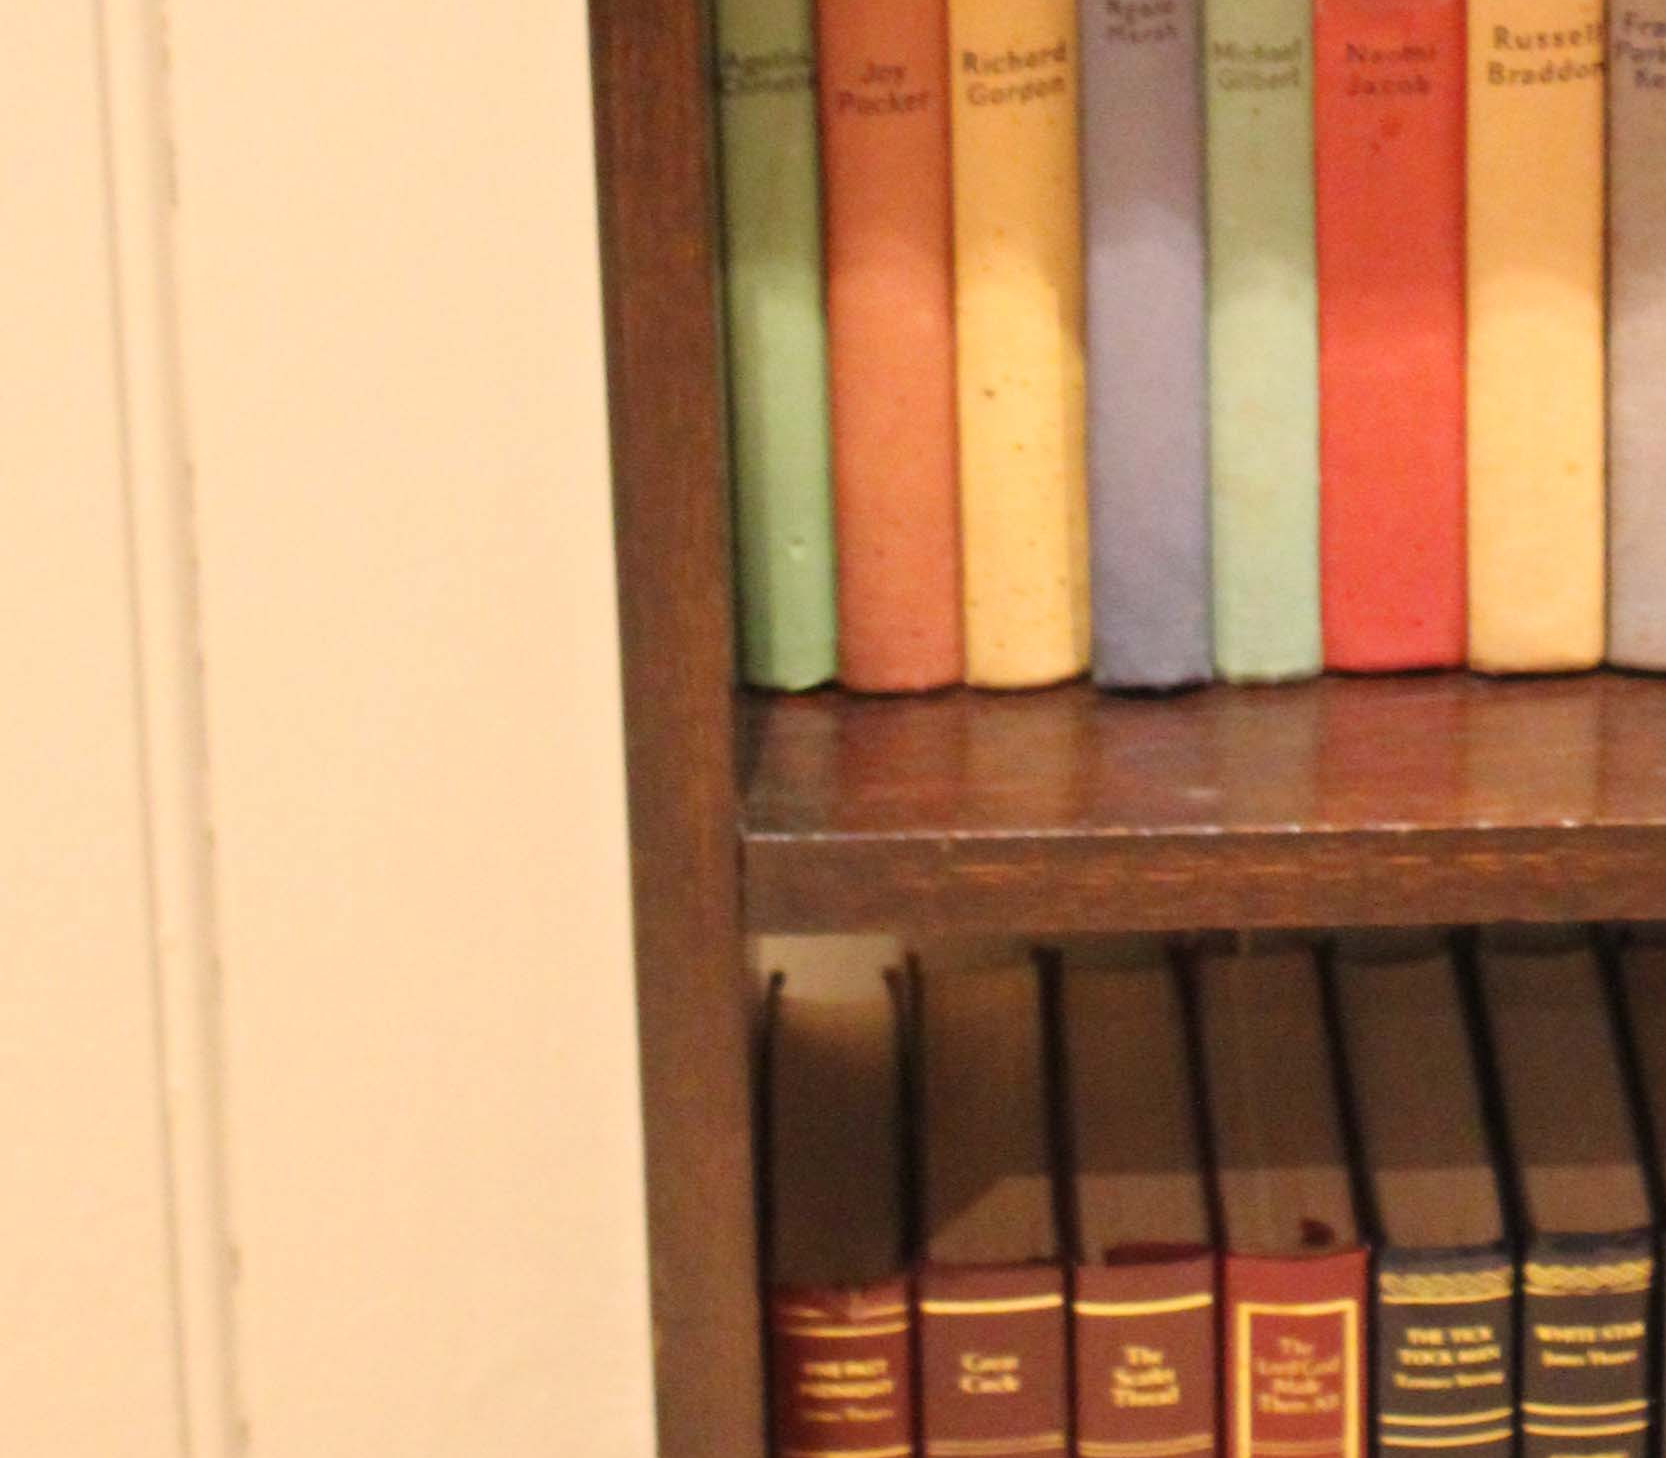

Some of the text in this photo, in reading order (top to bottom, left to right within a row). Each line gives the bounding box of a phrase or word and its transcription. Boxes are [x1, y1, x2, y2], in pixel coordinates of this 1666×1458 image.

[1492, 23, 1603, 50] Russell
[962, 42, 1068, 71] Richard
[1488, 60, 1608, 85] Braddon
